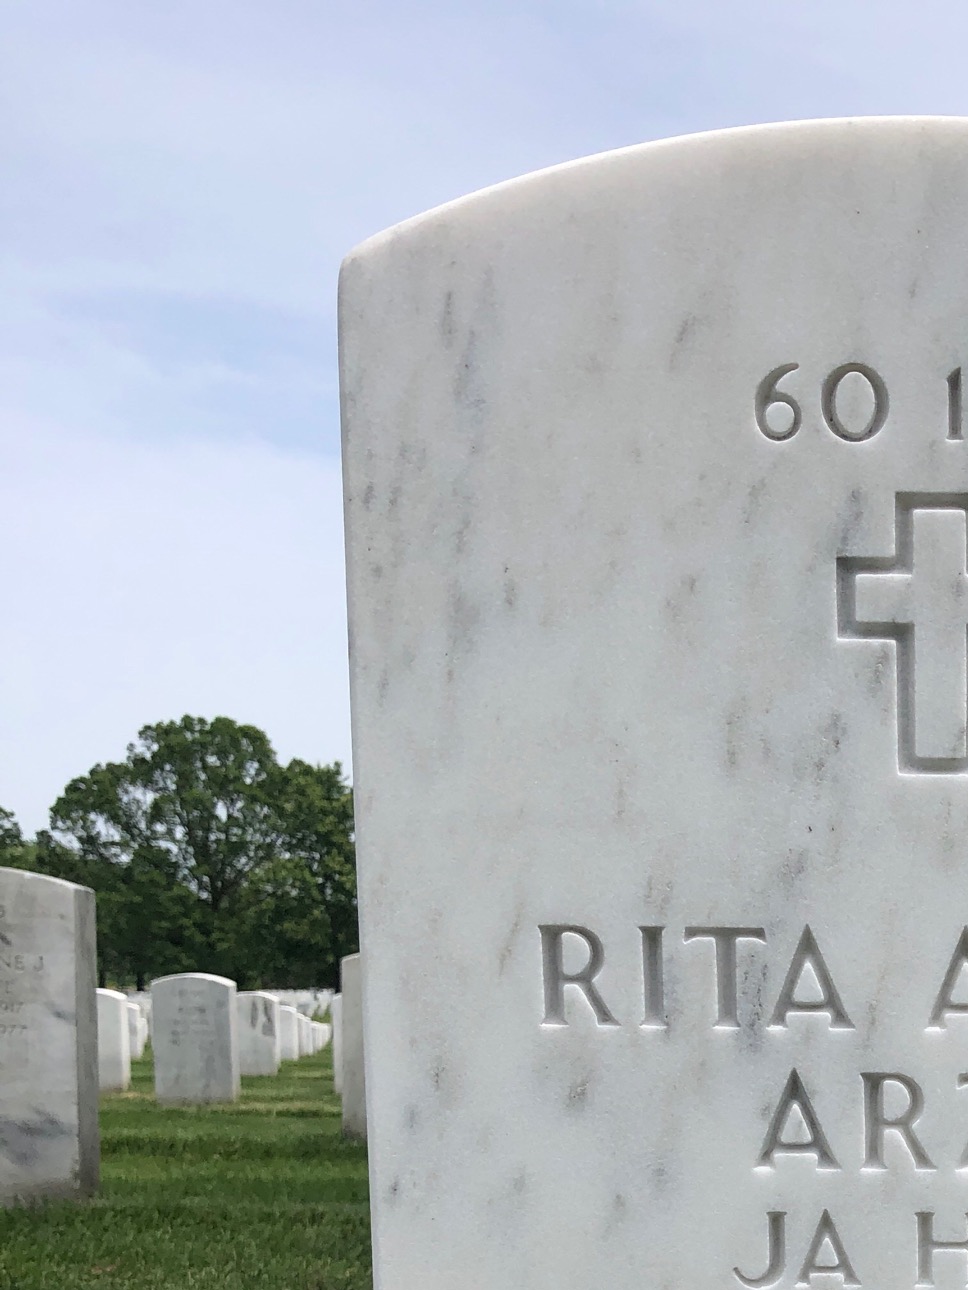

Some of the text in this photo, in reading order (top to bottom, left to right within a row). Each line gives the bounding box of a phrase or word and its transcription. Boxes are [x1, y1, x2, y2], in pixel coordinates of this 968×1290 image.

[754, 362, 890, 443] 60
[537, 923, 857, 1031] RITA
[732, 1208, 862, 1290] JA
